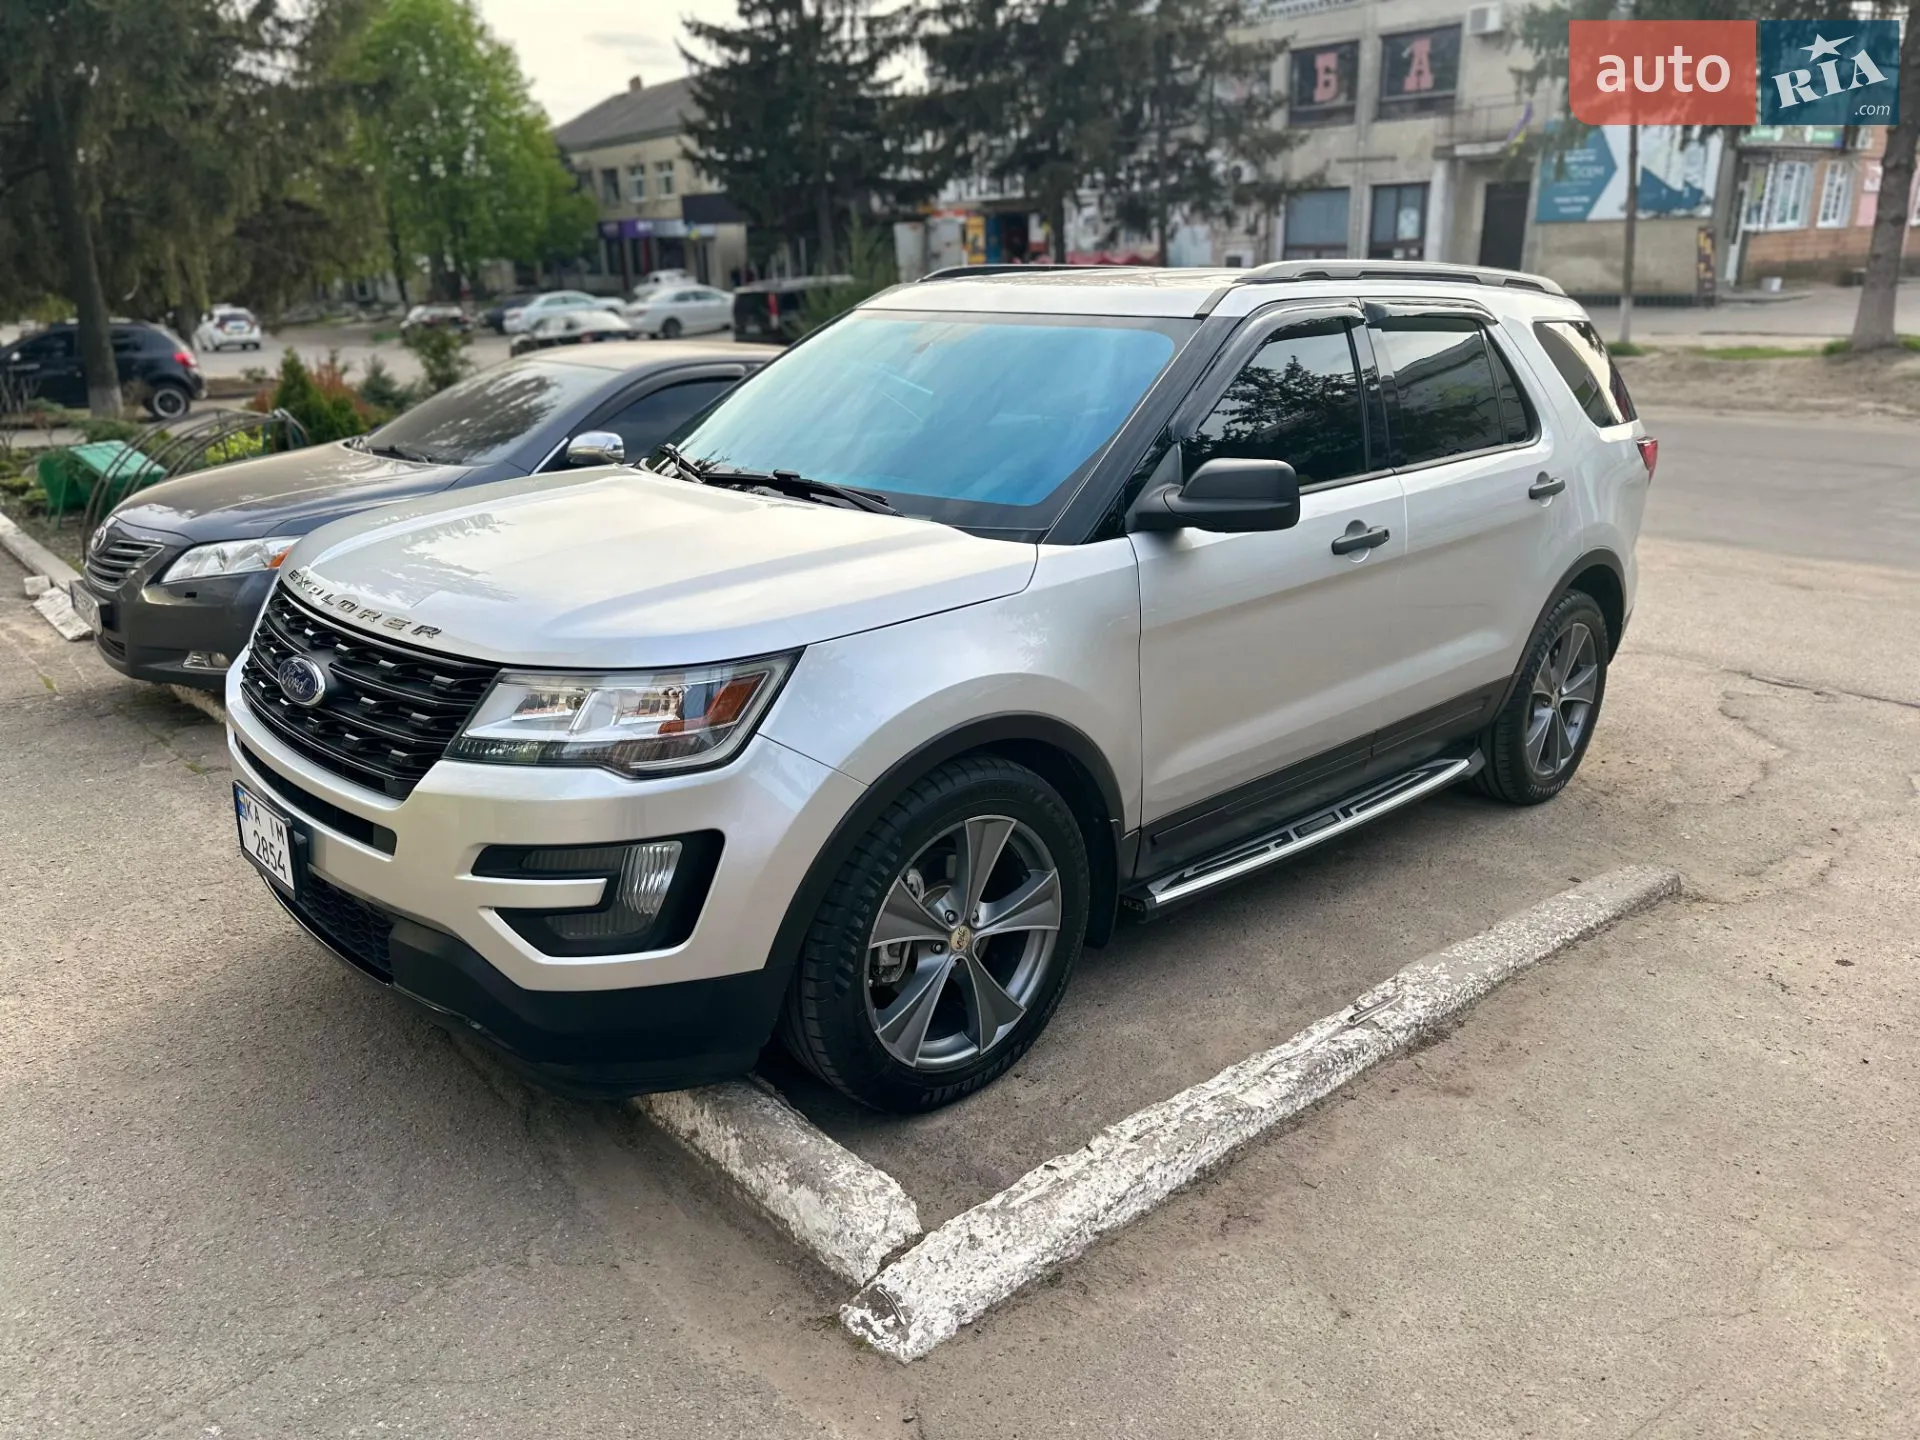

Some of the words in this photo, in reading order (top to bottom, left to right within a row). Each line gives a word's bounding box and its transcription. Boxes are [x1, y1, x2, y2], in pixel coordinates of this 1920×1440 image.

[288, 569, 442, 638] EXPLORER
[282, 662, 310, 694] Ford
[253, 829, 287, 880] 2854
